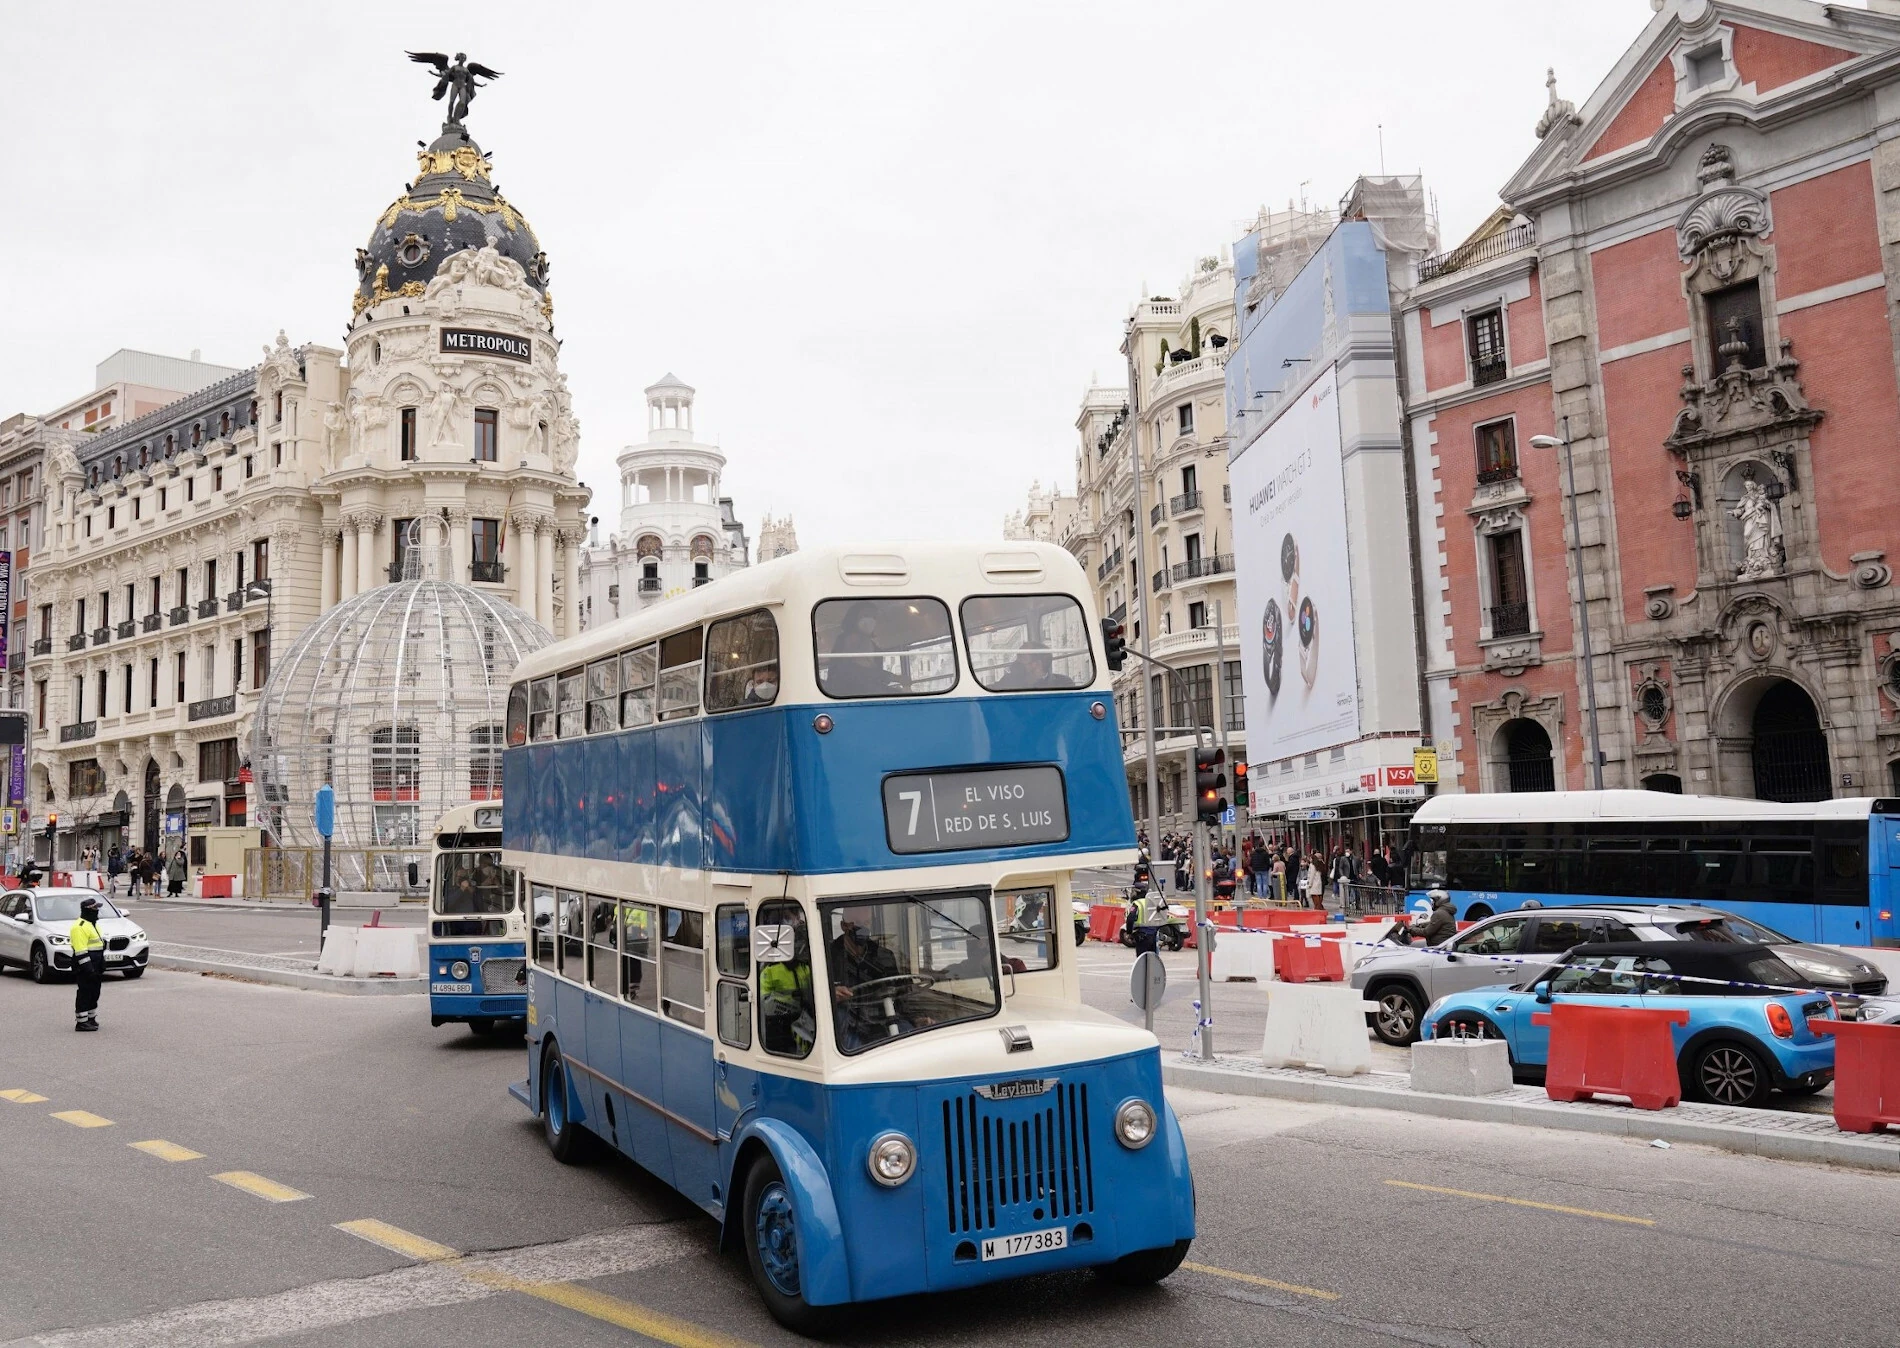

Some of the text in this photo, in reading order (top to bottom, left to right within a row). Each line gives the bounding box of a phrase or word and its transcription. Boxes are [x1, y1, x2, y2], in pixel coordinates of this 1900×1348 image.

[446, 333, 529, 357] METROPOLIS
[1318, 385, 1332, 402] HUAWEI
[1249, 448, 1312, 515] HUAWEI WATCH GT 3
[13, 753, 22, 795] FEMINISTAS
[965, 784, 1025, 802] EL VISO
[481, 810, 492, 825] 2
[899, 791, 922, 836] 7
[944, 810, 1052, 833] RED DE S. LUIS
[994, 1080, 1040, 1098] Leyland
[985, 1231, 1063, 1258] M 177383
